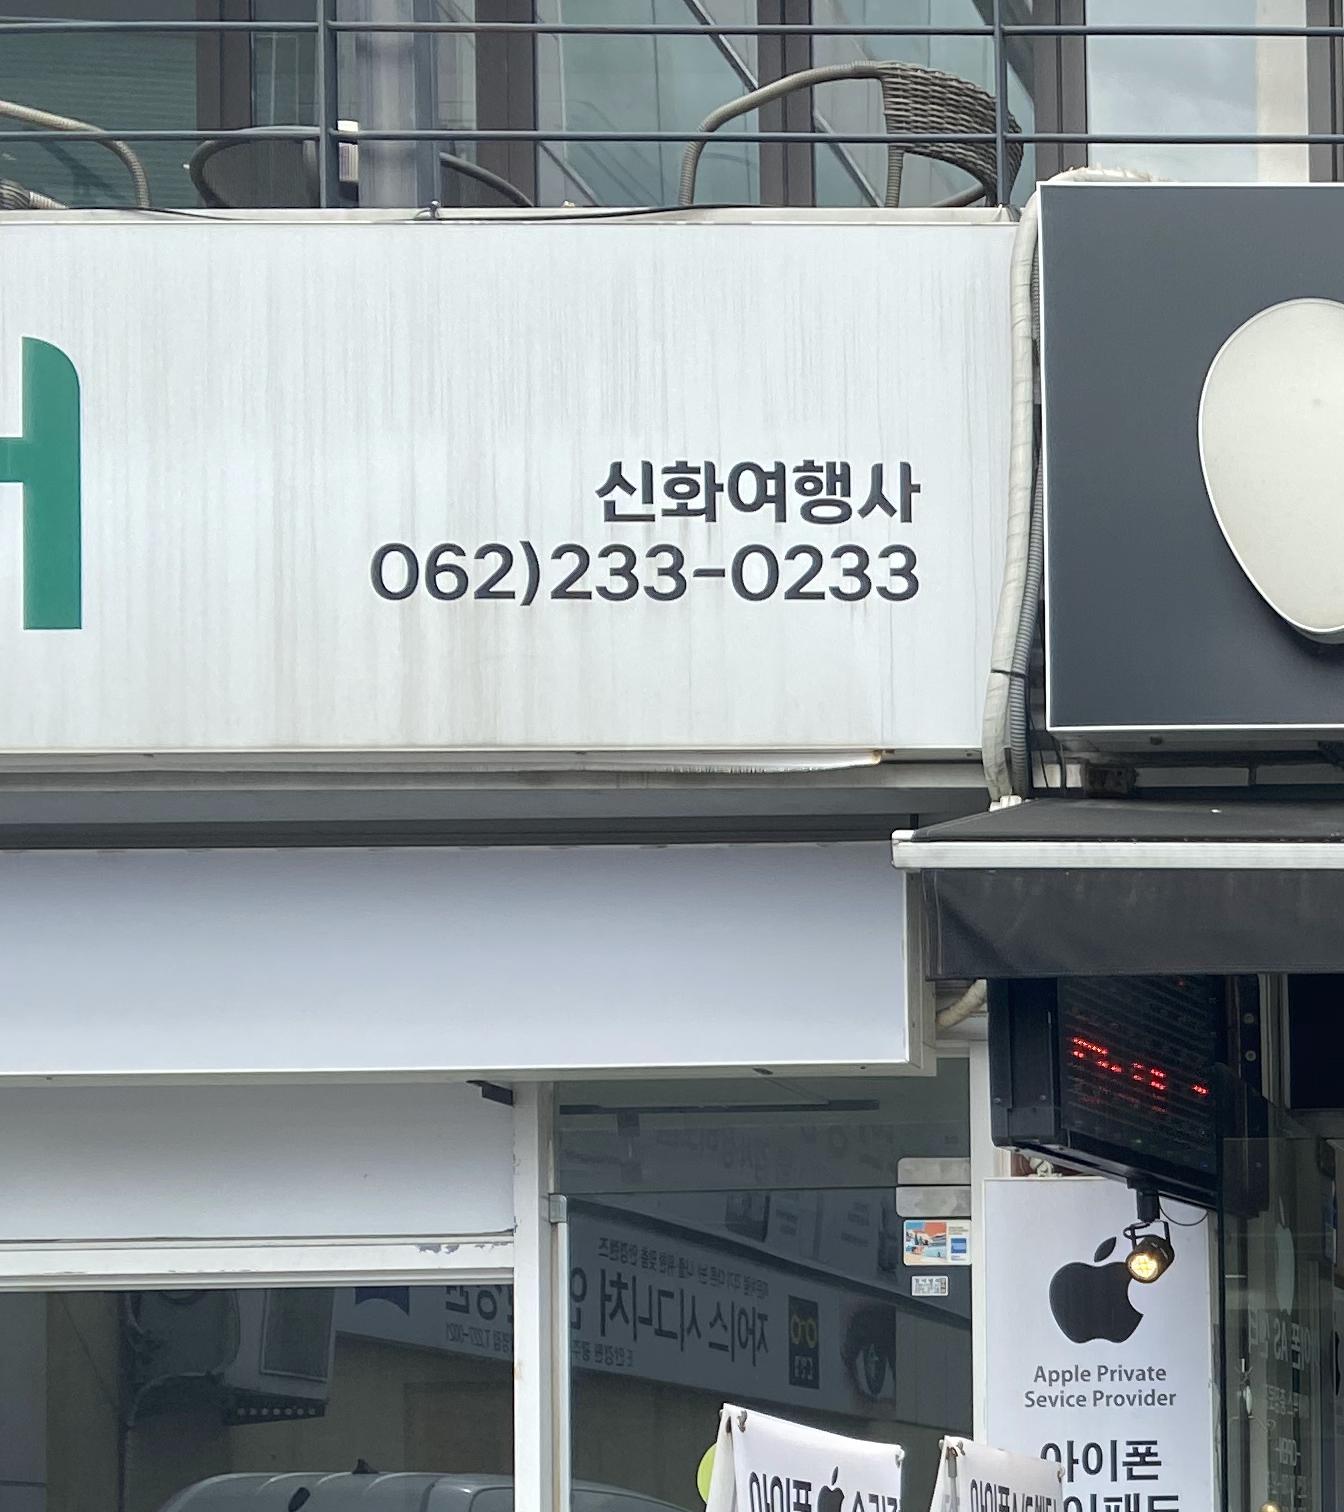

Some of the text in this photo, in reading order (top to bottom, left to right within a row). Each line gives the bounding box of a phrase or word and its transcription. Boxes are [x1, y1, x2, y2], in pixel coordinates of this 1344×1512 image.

[596, 460, 921, 524] 신화여행사
[370, 541, 920, 606] 062)233-0233
[1034, 1365, 1167, 1387] Apple Private
[1024, 1389, 1177, 1408] Sevice Provider
[1040, 1439, 1163, 1482] 아이폰
